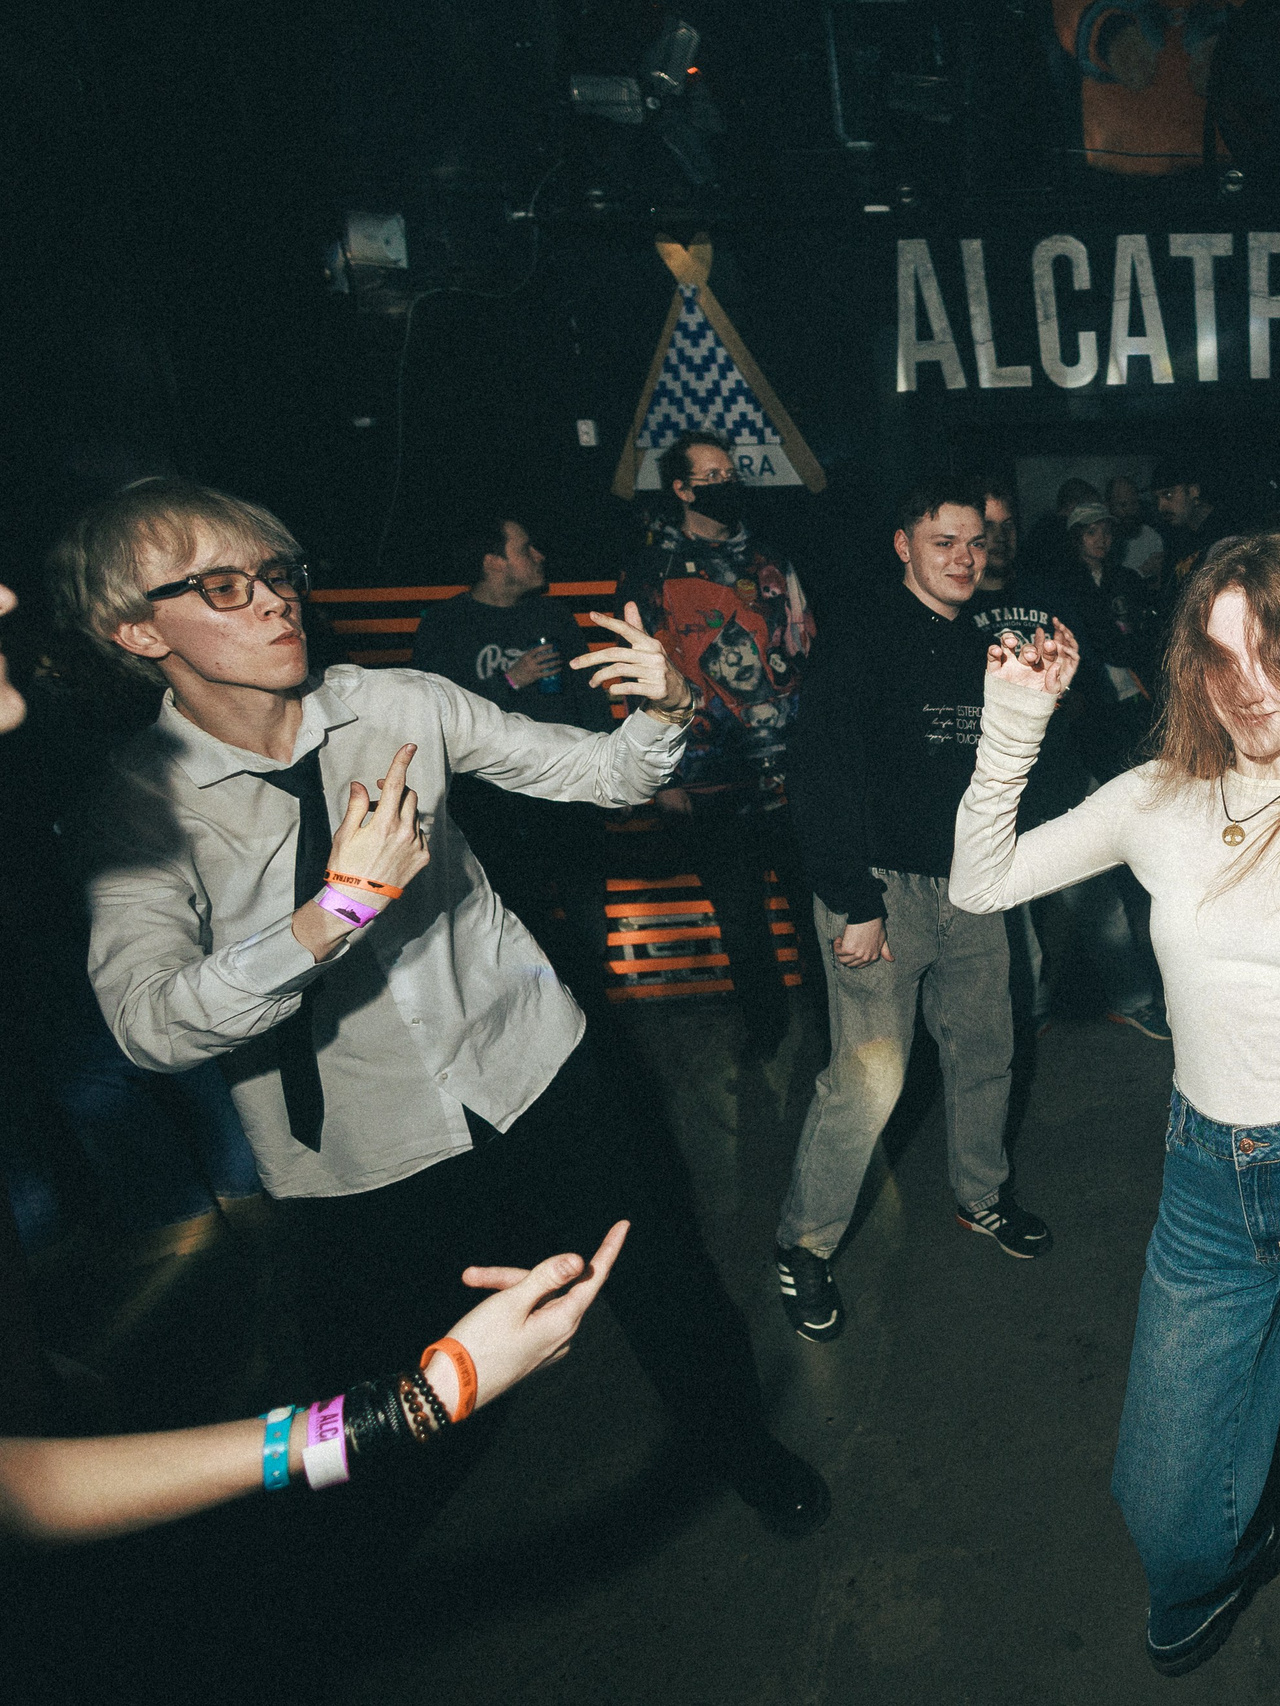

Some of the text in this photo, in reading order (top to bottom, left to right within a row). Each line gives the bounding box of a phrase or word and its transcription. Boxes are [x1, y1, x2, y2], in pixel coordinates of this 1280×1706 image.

[738, 454, 776, 477] RA
[991, 607, 1048, 625] TAILOR
[332, 873, 361, 885] ALCATRAZ
